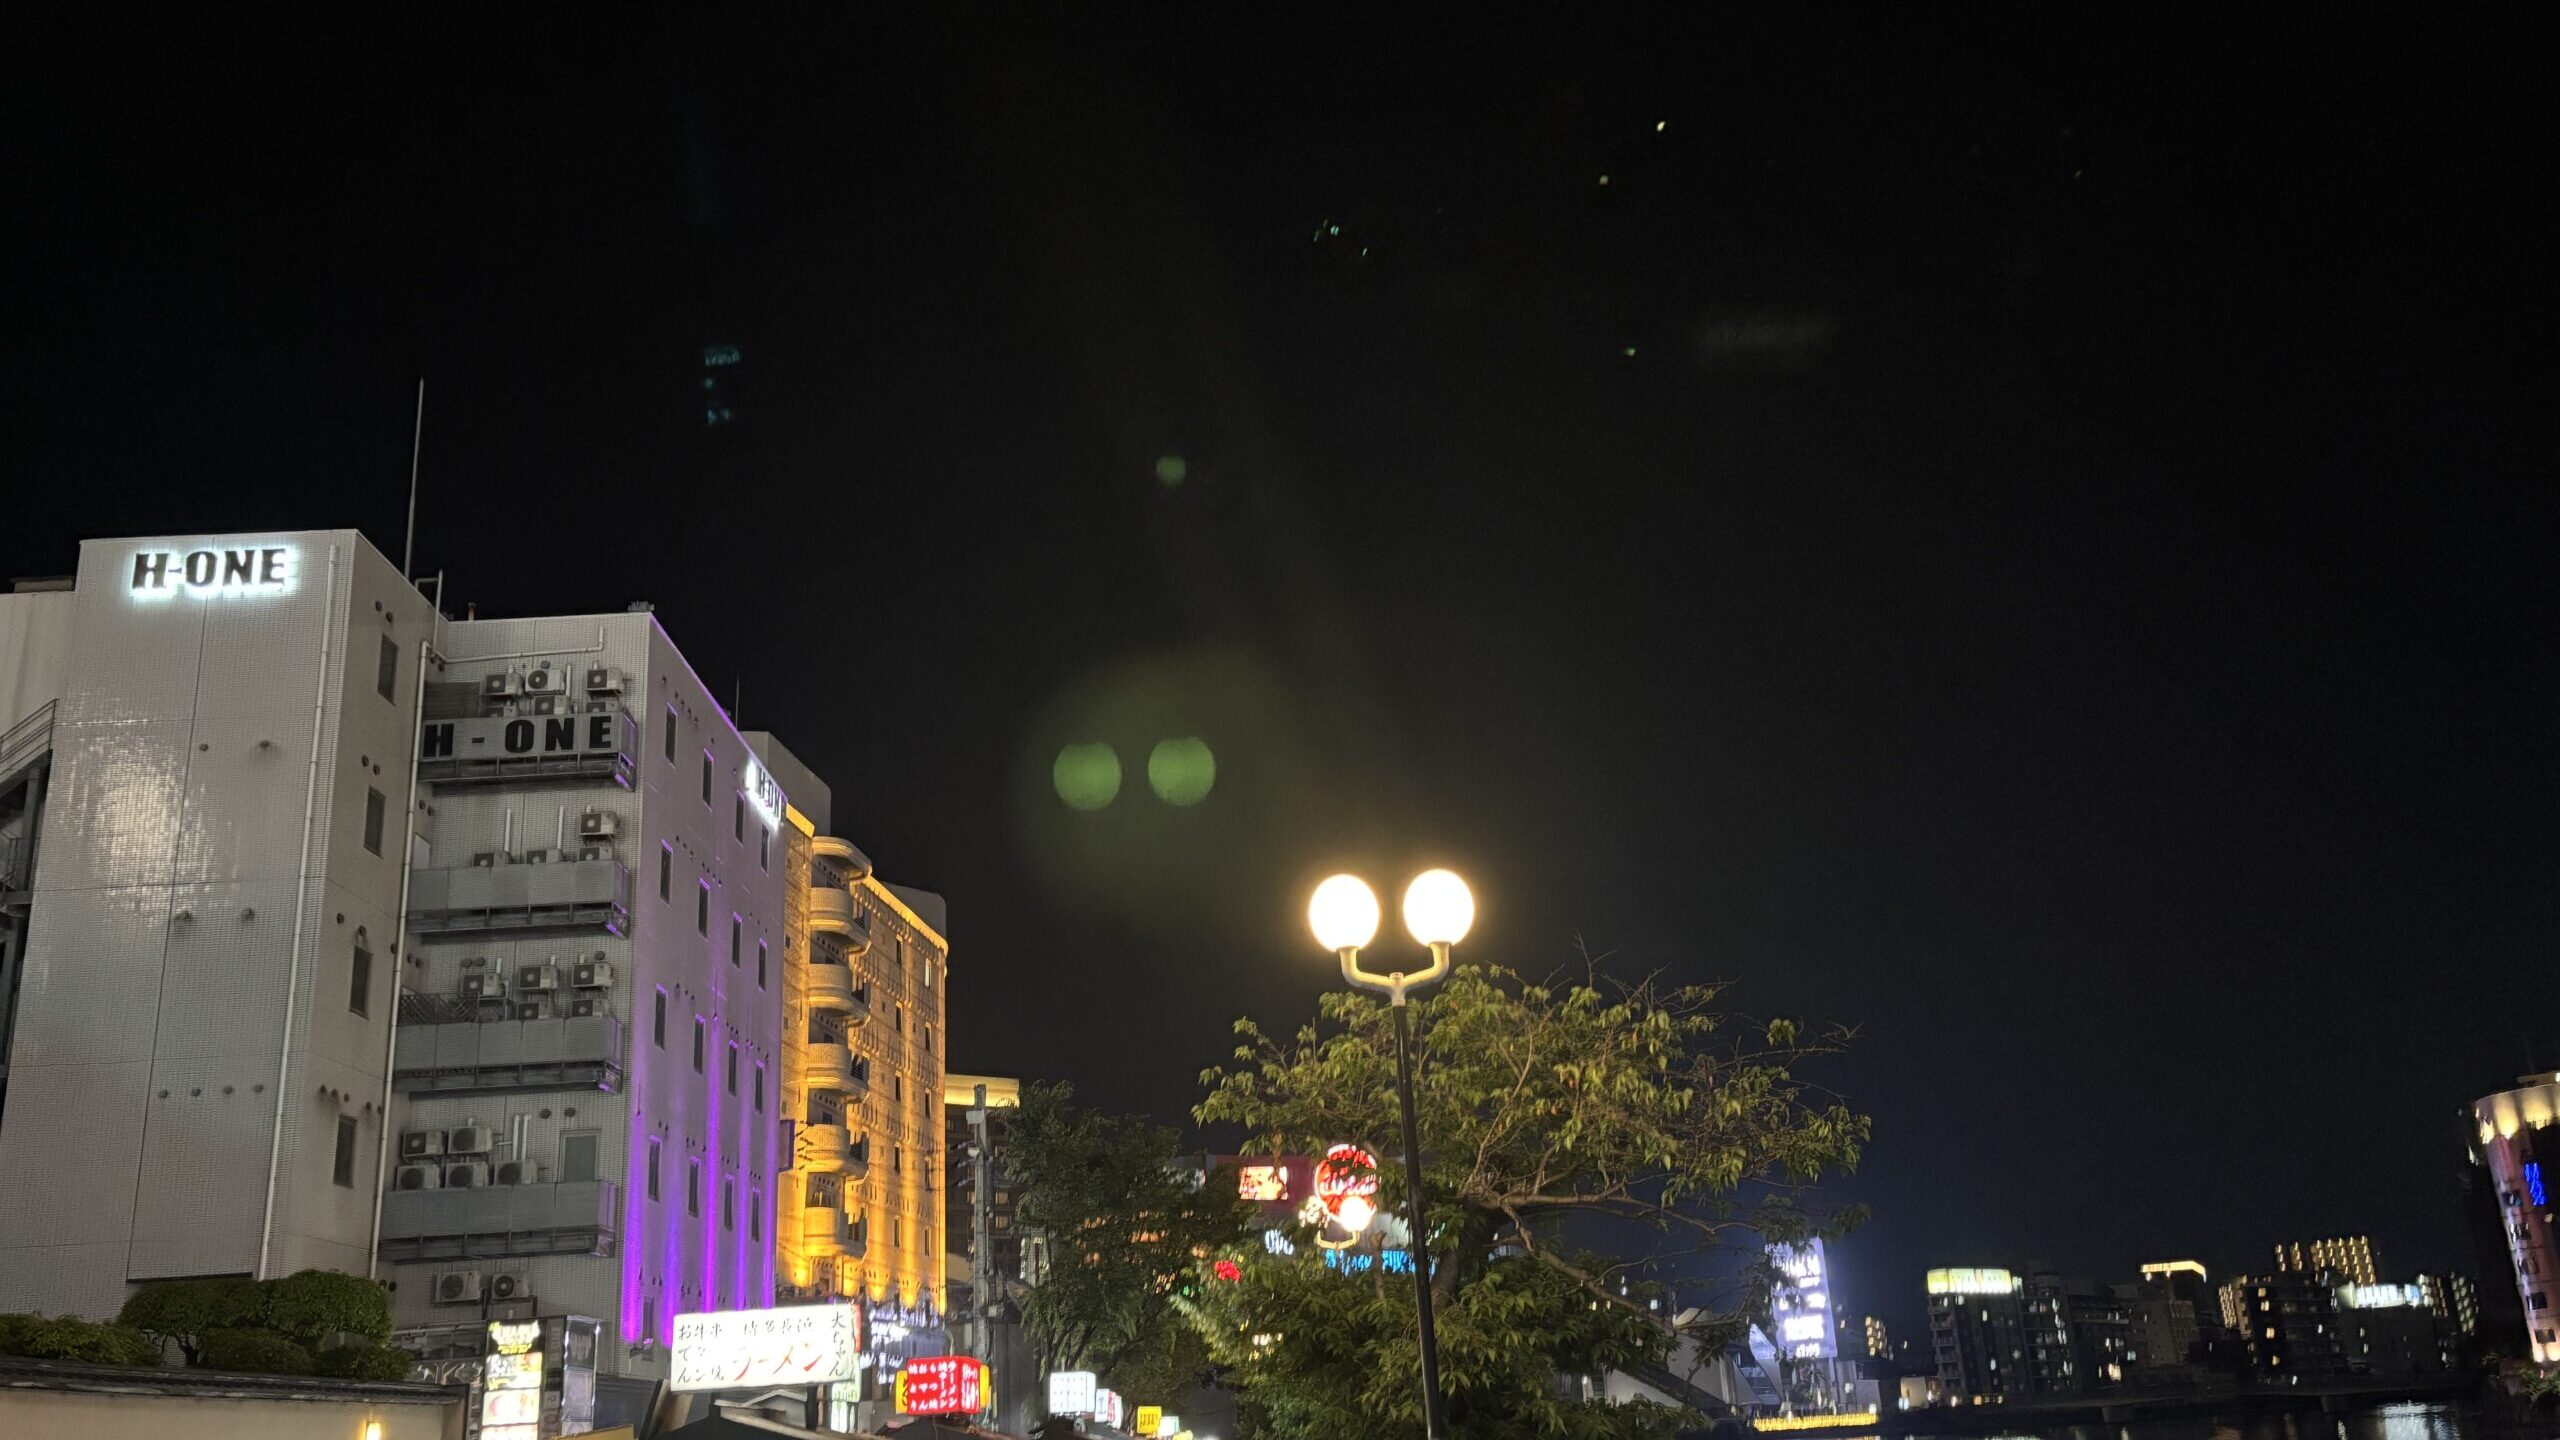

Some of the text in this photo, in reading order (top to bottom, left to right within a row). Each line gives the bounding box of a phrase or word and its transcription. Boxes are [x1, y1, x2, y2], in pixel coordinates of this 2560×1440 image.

[132, 549, 286, 589] H-ONE
[732, 1342, 824, 1382] ラーメン
[829, 1311, 846, 1377] 大ちゃん
